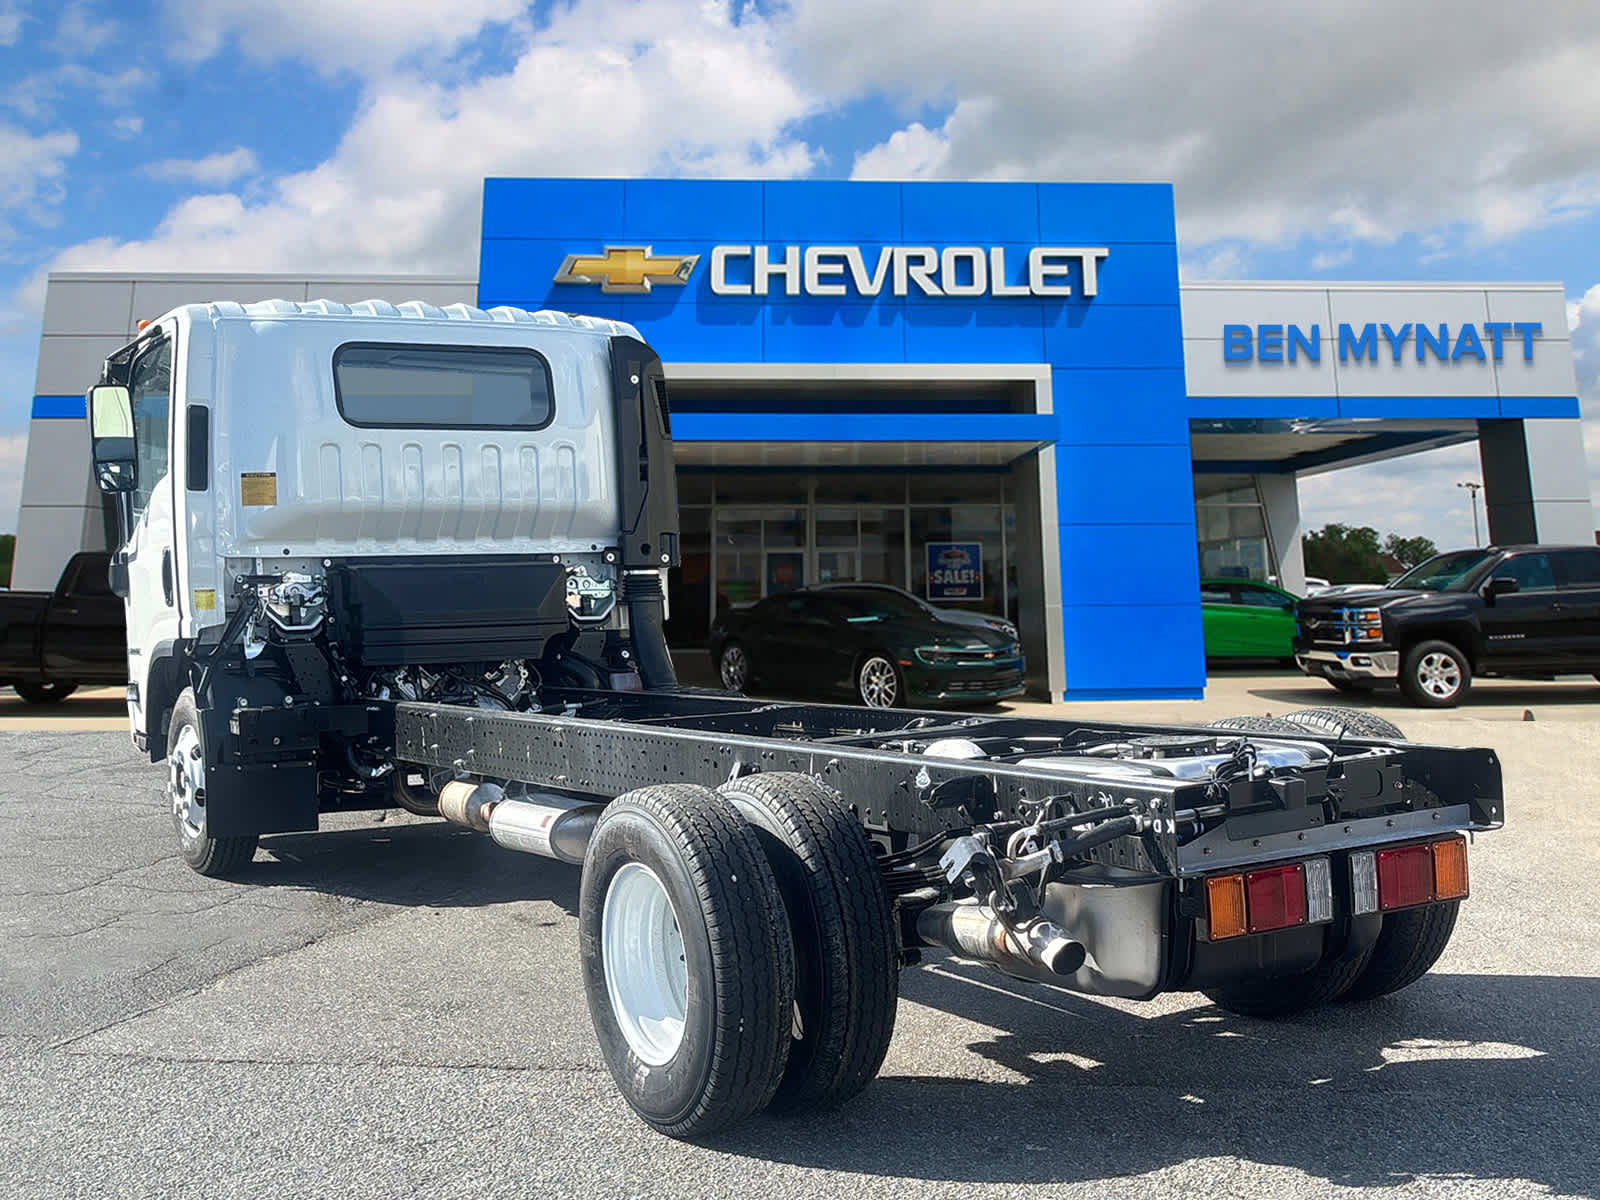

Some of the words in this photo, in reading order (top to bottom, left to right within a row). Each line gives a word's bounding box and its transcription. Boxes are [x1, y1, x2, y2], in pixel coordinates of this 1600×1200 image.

[710, 245, 1109, 297] CHEVROLET
[1223, 323, 1321, 362] BEN
[1338, 321, 1543, 362] MYNATT
[934, 569, 976, 585] SALE!
